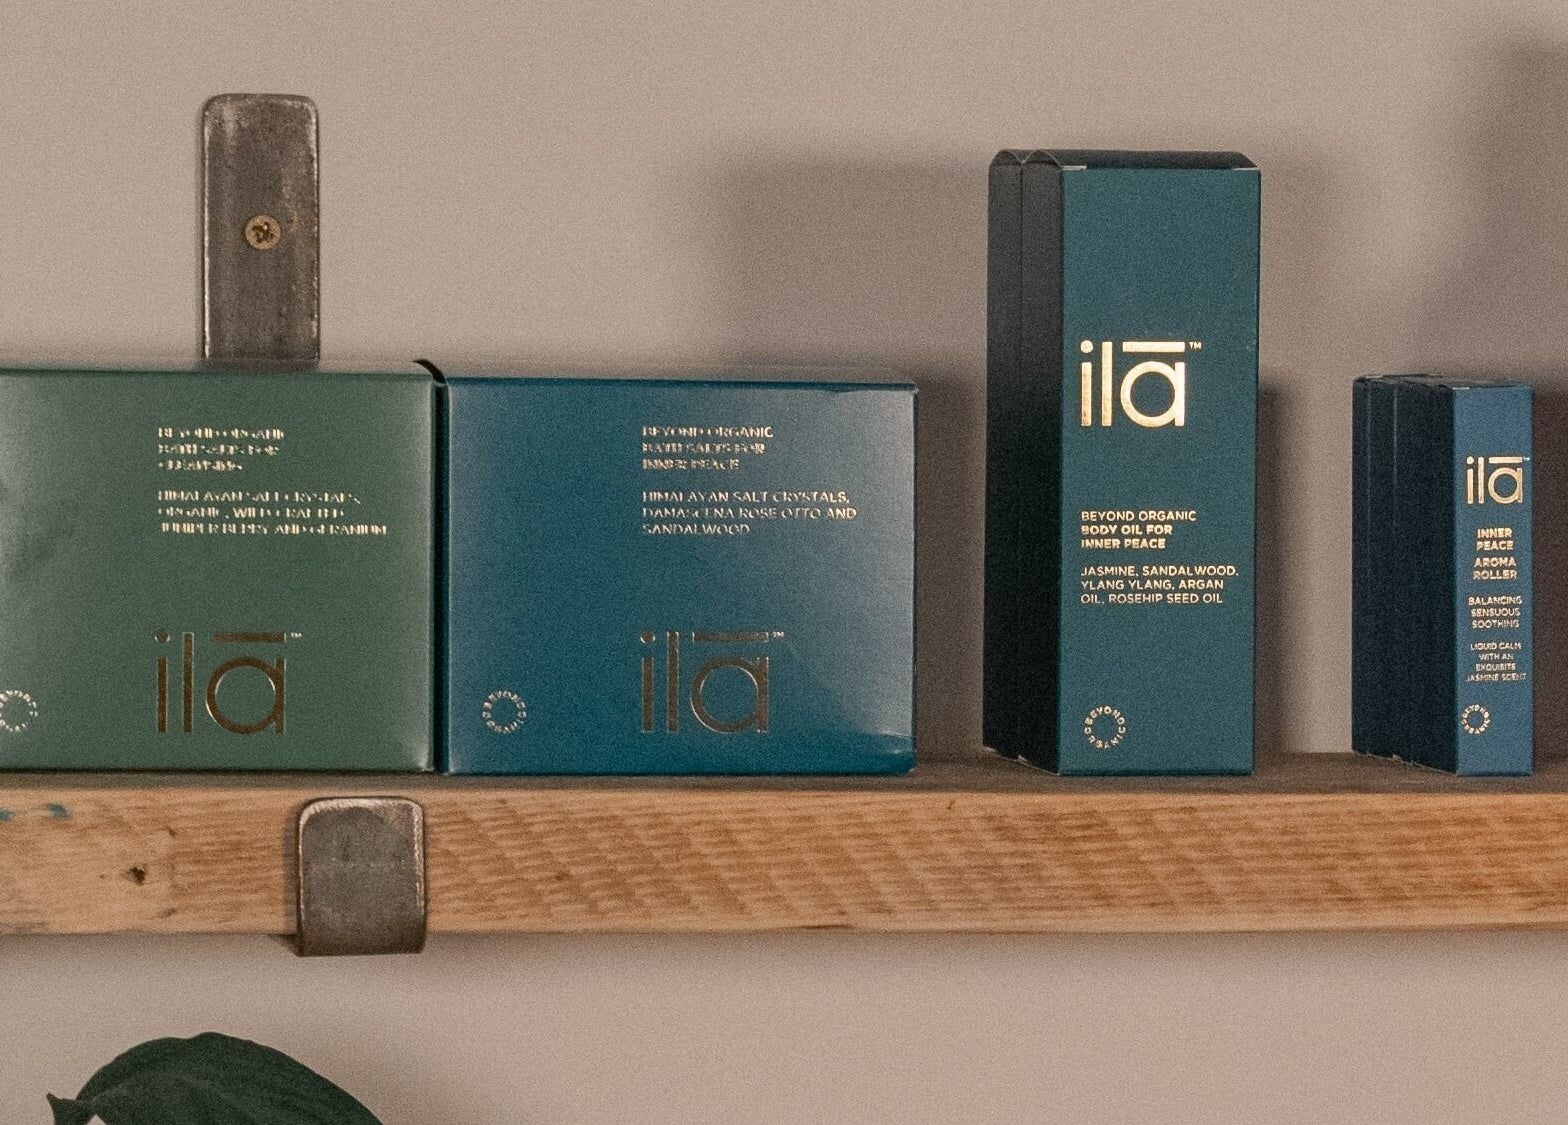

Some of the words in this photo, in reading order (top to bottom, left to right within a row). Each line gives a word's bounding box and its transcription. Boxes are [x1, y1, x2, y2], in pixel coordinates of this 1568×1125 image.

[642, 426, 704, 437] BEYOND
[707, 426, 774, 438] ORGANIC
[642, 491, 729, 502] HIMALAYAN
[732, 491, 769, 503] SALT
[642, 507, 735, 519] DAMASCENA
[738, 508, 777, 519] ROSE
[781, 508, 822, 519] OTTO
[825, 508, 858, 520] AND
[1081, 511, 1134, 521] BEYOND
[1138, 511, 1197, 521] ORGANIC
[642, 523, 751, 535] SANDALWOOD
[1081, 525, 1118, 535] BODY
[1121, 525, 1143, 535] OIL
[1146, 525, 1173, 535] FOR
[1477, 528, 1513, 538] INNER
[1081, 539, 1120, 549] INNER
[1124, 539, 1166, 549] PEACE
[1476, 540, 1514, 551] PEACE
[1474, 557, 1517, 568] AROMA
[1080, 566, 1139, 577] JASMINE,
[1142, 566, 1239, 577] SANDALWOOD,
[1473, 570, 1517, 580] ROLLER
[1081, 580, 1125, 590] YLANG
[1128, 580, 1175, 591] YLANG,
[1178, 580, 1224, 590] ARGAN
[1080, 594, 1105, 604] OIL,
[1109, 594, 1163, 604] ROSEHIP
[1166, 594, 1200, 604] SEED
[1202, 594, 1223, 604] OIL
[1468, 596, 1523, 606] BALANCING
[1471, 608, 1521, 618] SENSUOUS
[1471, 620, 1520, 629] SOOTHING
[1470, 642, 1497, 651] LIQUID
[1499, 642, 1522, 650] CALM
[1479, 653, 1499, 661] WITH
[1475, 663, 1516, 671] EXQUISITE
[1467, 673, 1499, 681] JASMINE
[1502, 672, 1527, 681] SCENT
